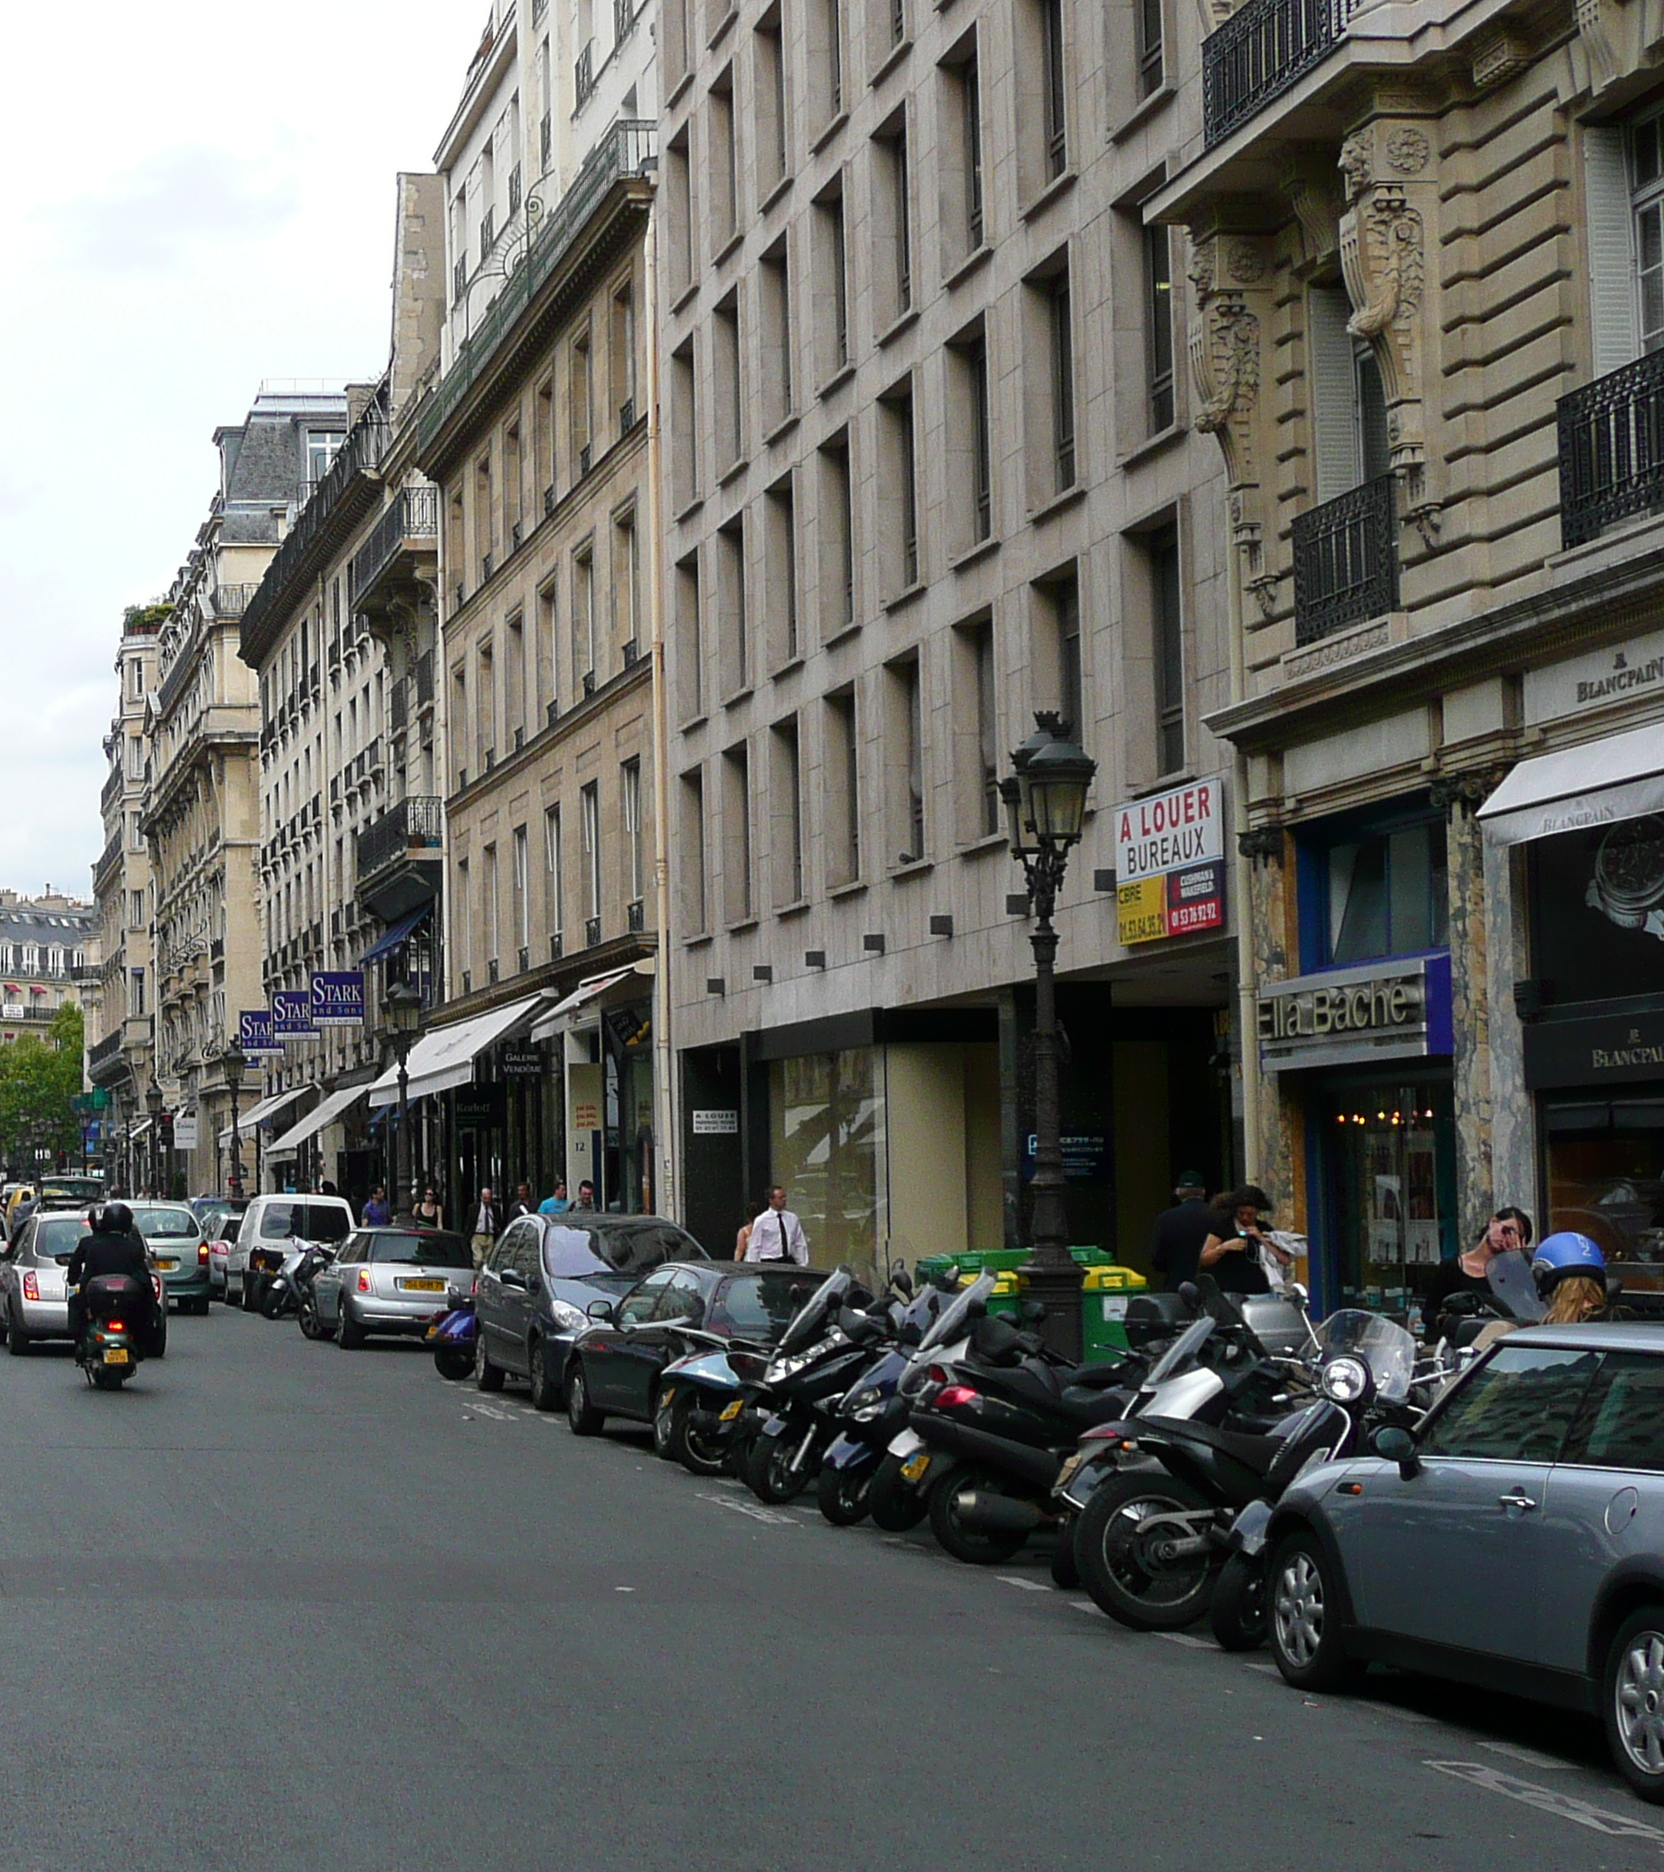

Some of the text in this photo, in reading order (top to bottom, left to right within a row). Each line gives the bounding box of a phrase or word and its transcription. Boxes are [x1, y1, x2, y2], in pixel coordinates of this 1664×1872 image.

[1577, 656, 1664, 702] BLANCPAIN
[1121, 786, 1211, 843] A LOUER
[1544, 806, 1614, 834] BLANCPAIN
[1128, 826, 1205, 875] BUREAUX
[1118, 884, 1141, 904] CBRE
[312, 977, 362, 1005] STARK
[312, 1006, 362, 1014] and Sons
[1256, 978, 1407, 1040] Ella Baché
[505, 1053, 539, 1062] GALERIE
[575, 1142, 585, 1151] 12
